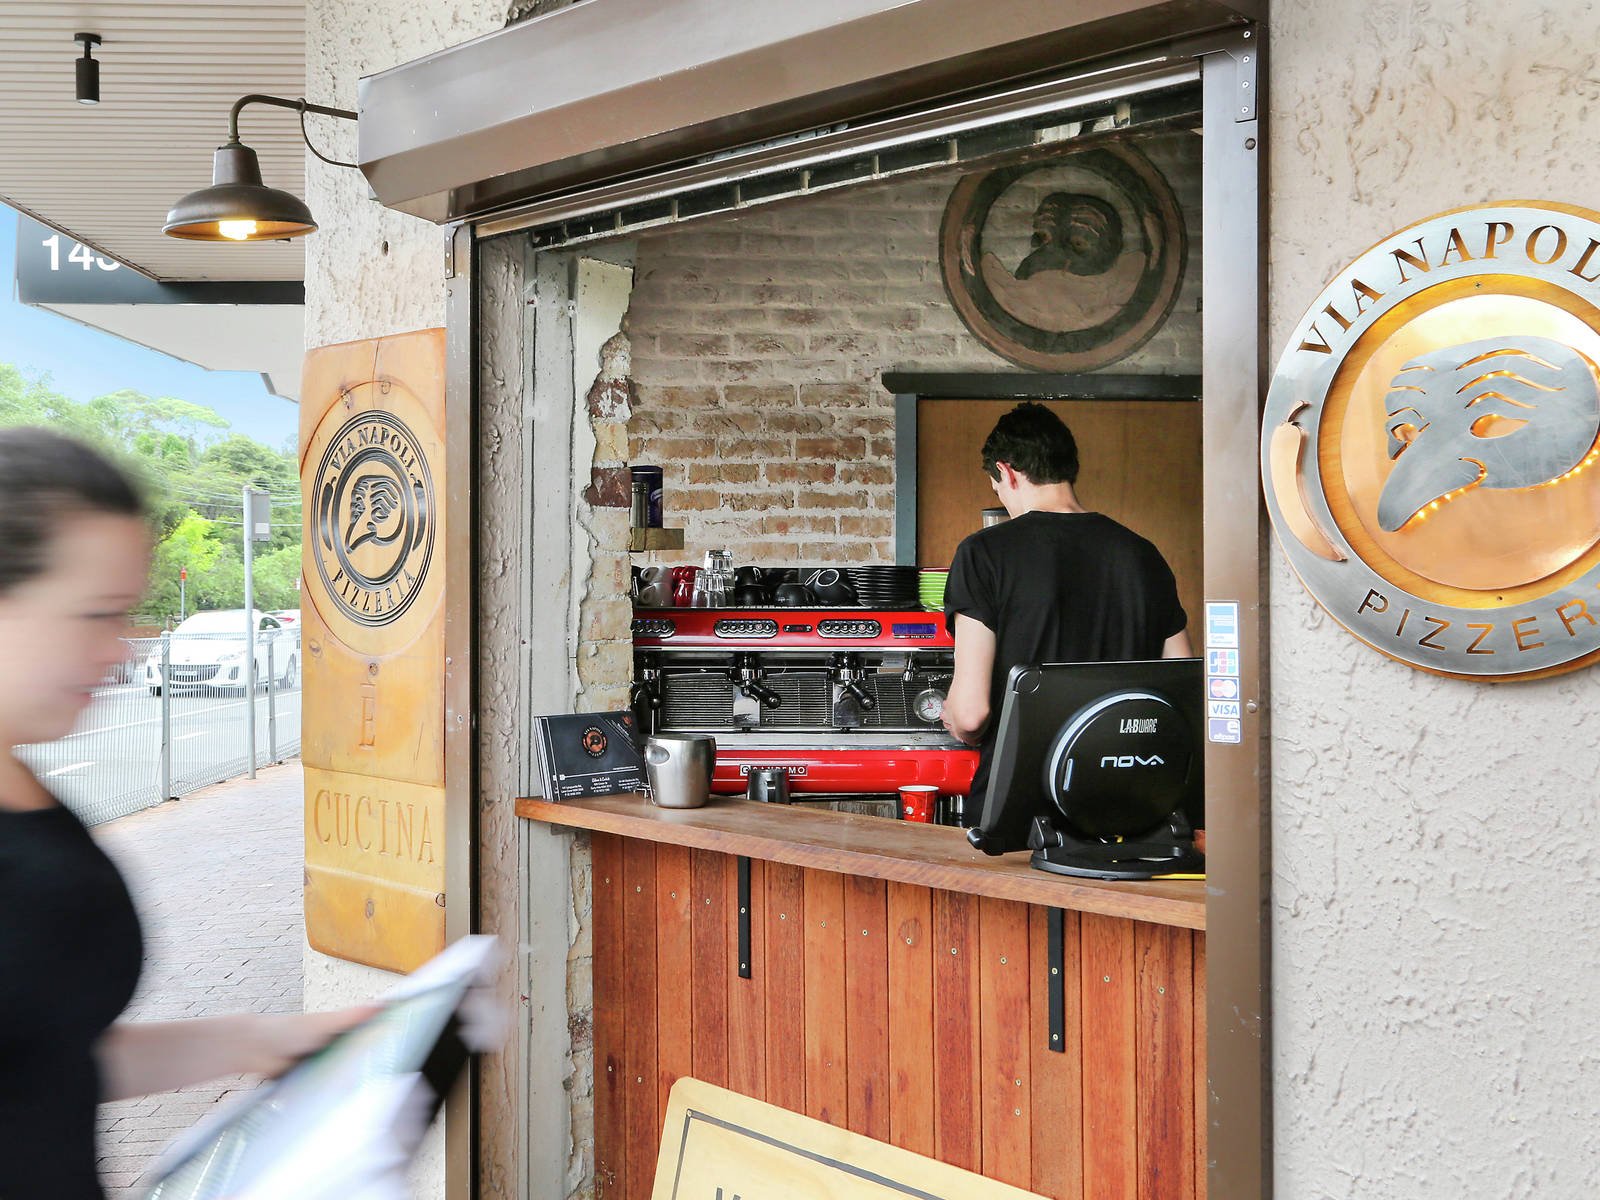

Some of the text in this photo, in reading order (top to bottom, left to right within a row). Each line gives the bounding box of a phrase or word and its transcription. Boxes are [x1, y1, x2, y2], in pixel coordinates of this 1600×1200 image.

[1296, 278, 1385, 356] VIA
[330, 425, 417, 473] VIA NAPOLI
[332, 567, 416, 614] PIZZERIA
[1357, 583, 1600, 655] PIZZER
[1212, 704, 1238, 715] VISA
[313, 788, 434, 864] CUCINA
